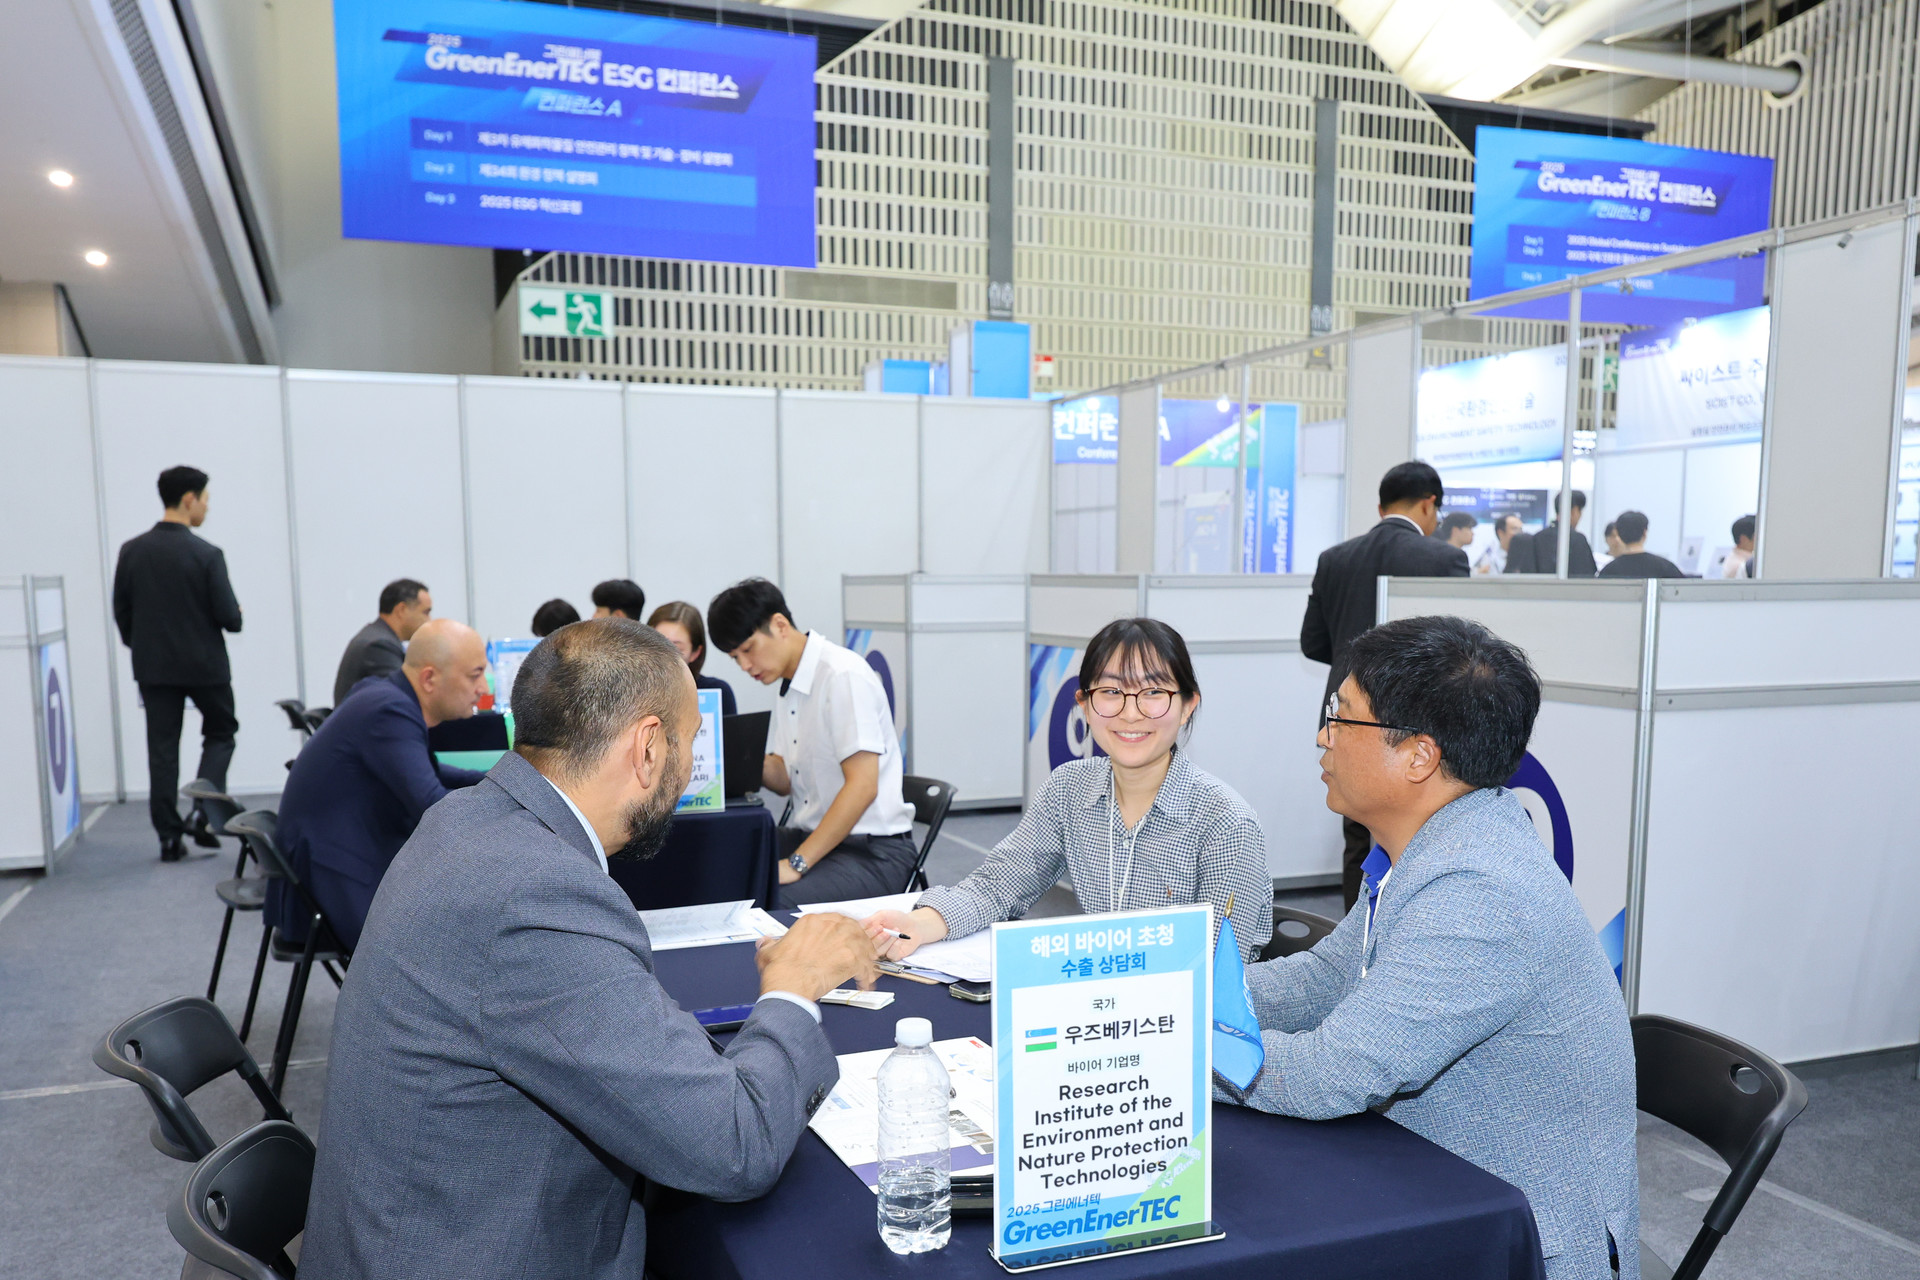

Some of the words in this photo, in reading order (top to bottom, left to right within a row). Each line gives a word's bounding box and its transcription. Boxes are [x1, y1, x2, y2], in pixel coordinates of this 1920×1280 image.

[427, 33, 462, 48] 2025
[425, 46, 600, 85] GreenEnerTEC
[602, 62, 654, 90] ESG
[656, 67, 740, 100] 컨퍼런스
[605, 99, 623, 117] A
[424, 129, 445, 143] Day
[424, 161, 445, 175] Day
[425, 191, 446, 206] Day
[1537, 172, 1656, 201] GreenEnerTEC
[480, 194, 512, 209] 2025
[512, 197, 538, 211] ESG
[1031, 932, 1069, 957] 해외
[1075, 930, 1132, 955] 바이어
[1137, 923, 1174, 946] 초청
[1061, 957, 1094, 978] 수출
[1098, 952, 1146, 975] 상담회
[1092, 997, 1115, 1011] 국가
[1065, 1014, 1175, 1045] 우즈베키스탄
[1068, 1058, 1103, 1074] 바이어
[1106, 1054, 1141, 1070] 기업명
[1059, 1075, 1149, 1100] Research
[1035, 1102, 1114, 1126] Institute
[1119, 1097, 1137, 1114] of
[1142, 1095, 1172, 1113] the
[1023, 1120, 1144, 1149] Environment
[1149, 1112, 1184, 1129] and
[1018, 1149, 1086, 1172] Nature
[1091, 1134, 1188, 1161] Protection
[1041, 1157, 1168, 1190] Technologies
[1007, 1204, 1041, 1219] 2025
[1043, 1192, 1102, 1214] 그린에너텍
[1003, 1195, 1181, 1246] GreenEnerTEC
